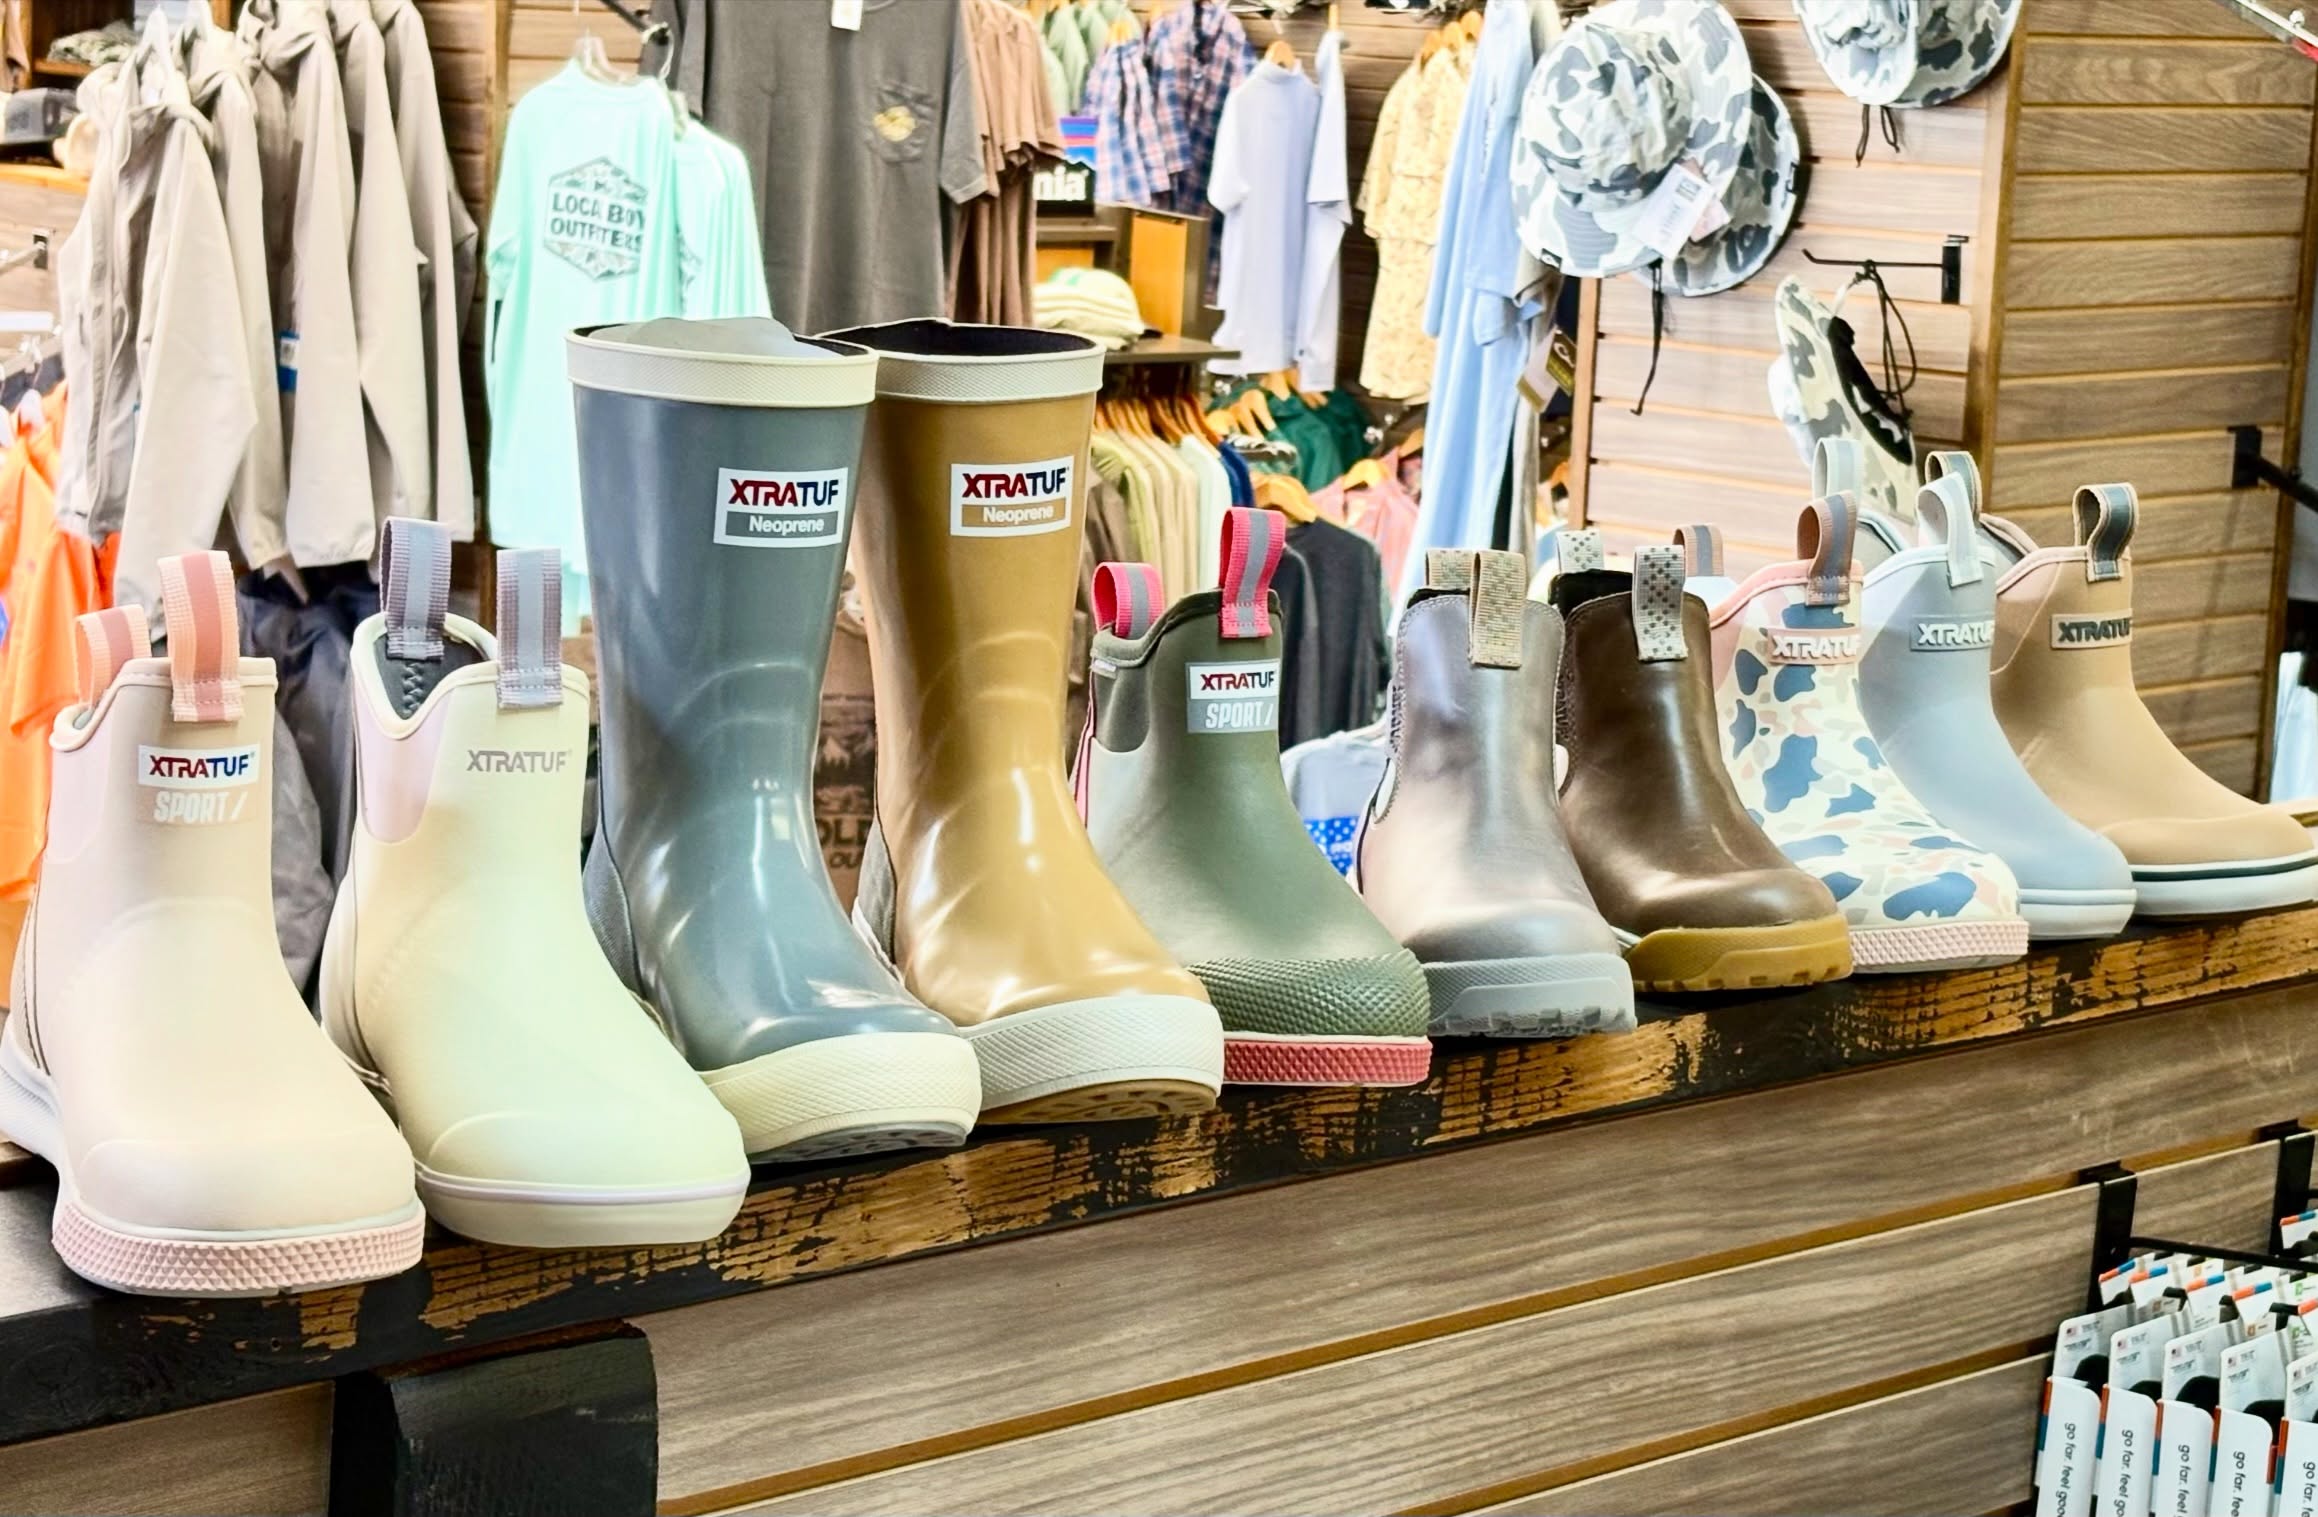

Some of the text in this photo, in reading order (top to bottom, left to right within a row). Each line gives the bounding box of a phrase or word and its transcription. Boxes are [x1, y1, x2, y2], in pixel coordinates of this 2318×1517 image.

[727, 478, 840, 508] XTRATUF
[961, 466, 1067, 499] XTRATUF
[748, 514, 825, 537] Neoprene
[982, 505, 1055, 525] Neoprene
[2058, 616, 2131, 643] XTRATU
[1200, 670, 1276, 691] XTRATUF
[149, 753, 249, 779] XTRATUF
[466, 748, 567, 774] XTRATUF
[2064, 1422, 2076, 1440] go
[2121, 1429, 2134, 1447] go
[2178, 1444, 2190, 1463] go
[2233, 1450, 2246, 1470] go
[2060, 1465, 2074, 1490] feel
[2303, 1461, 2316, 1480] go
[2119, 1473, 2132, 1498] feel
[2055, 1490, 2068, 1517] goo
[2176, 1488, 2190, 1514] feel
